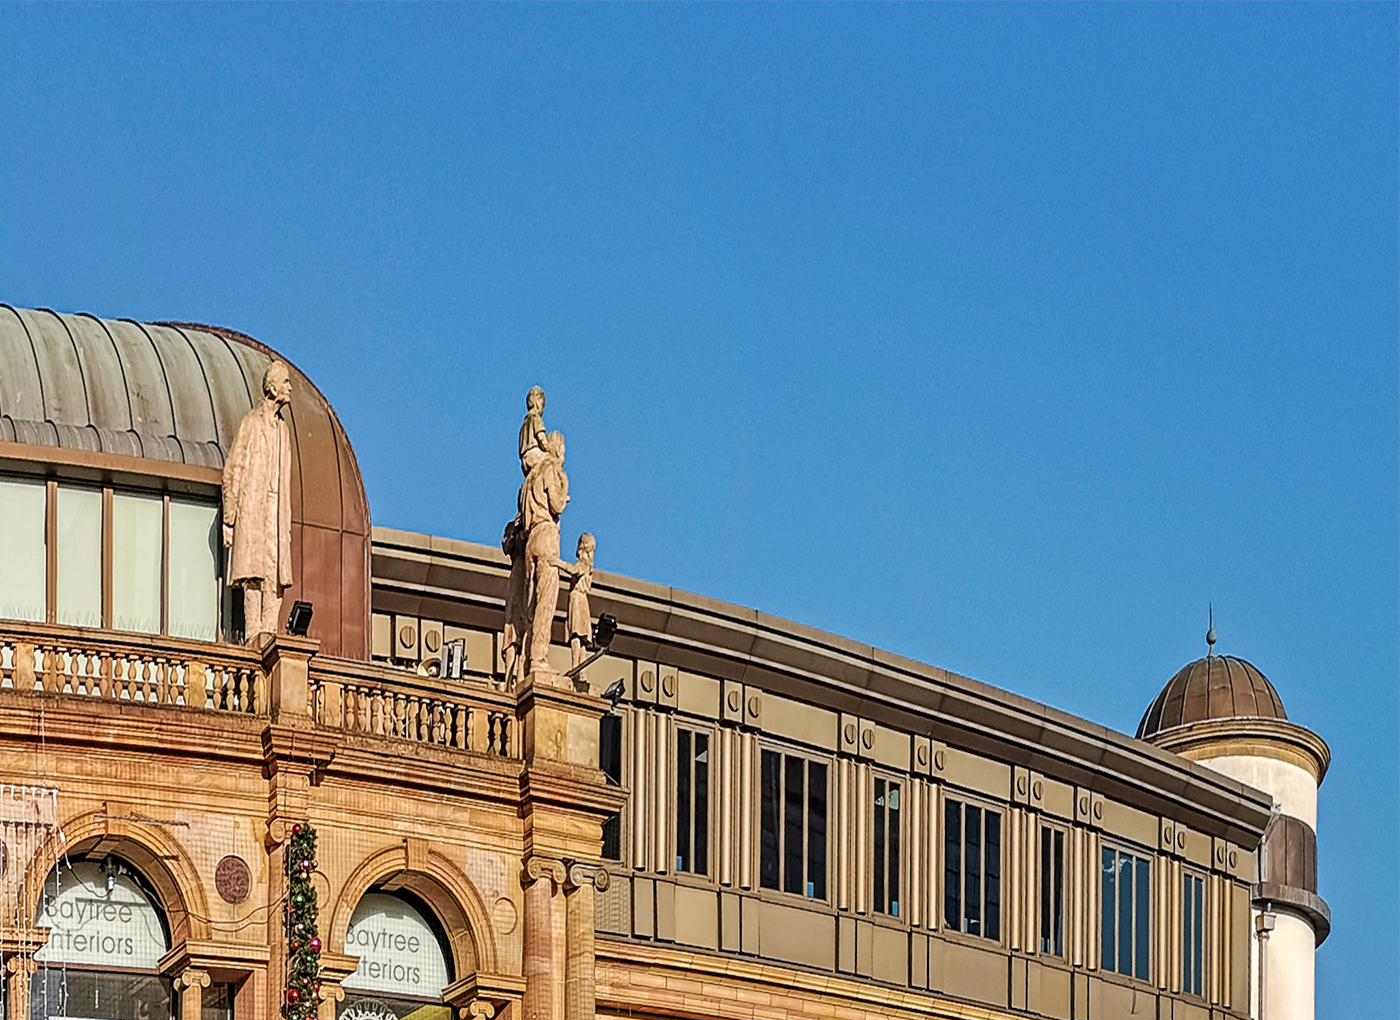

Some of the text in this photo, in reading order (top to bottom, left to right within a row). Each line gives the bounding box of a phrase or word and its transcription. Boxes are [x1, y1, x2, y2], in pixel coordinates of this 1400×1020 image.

[50, 928, 133, 955] nteriors
[346, 924, 420, 953] Baytree
[357, 956, 420, 984] teriors
